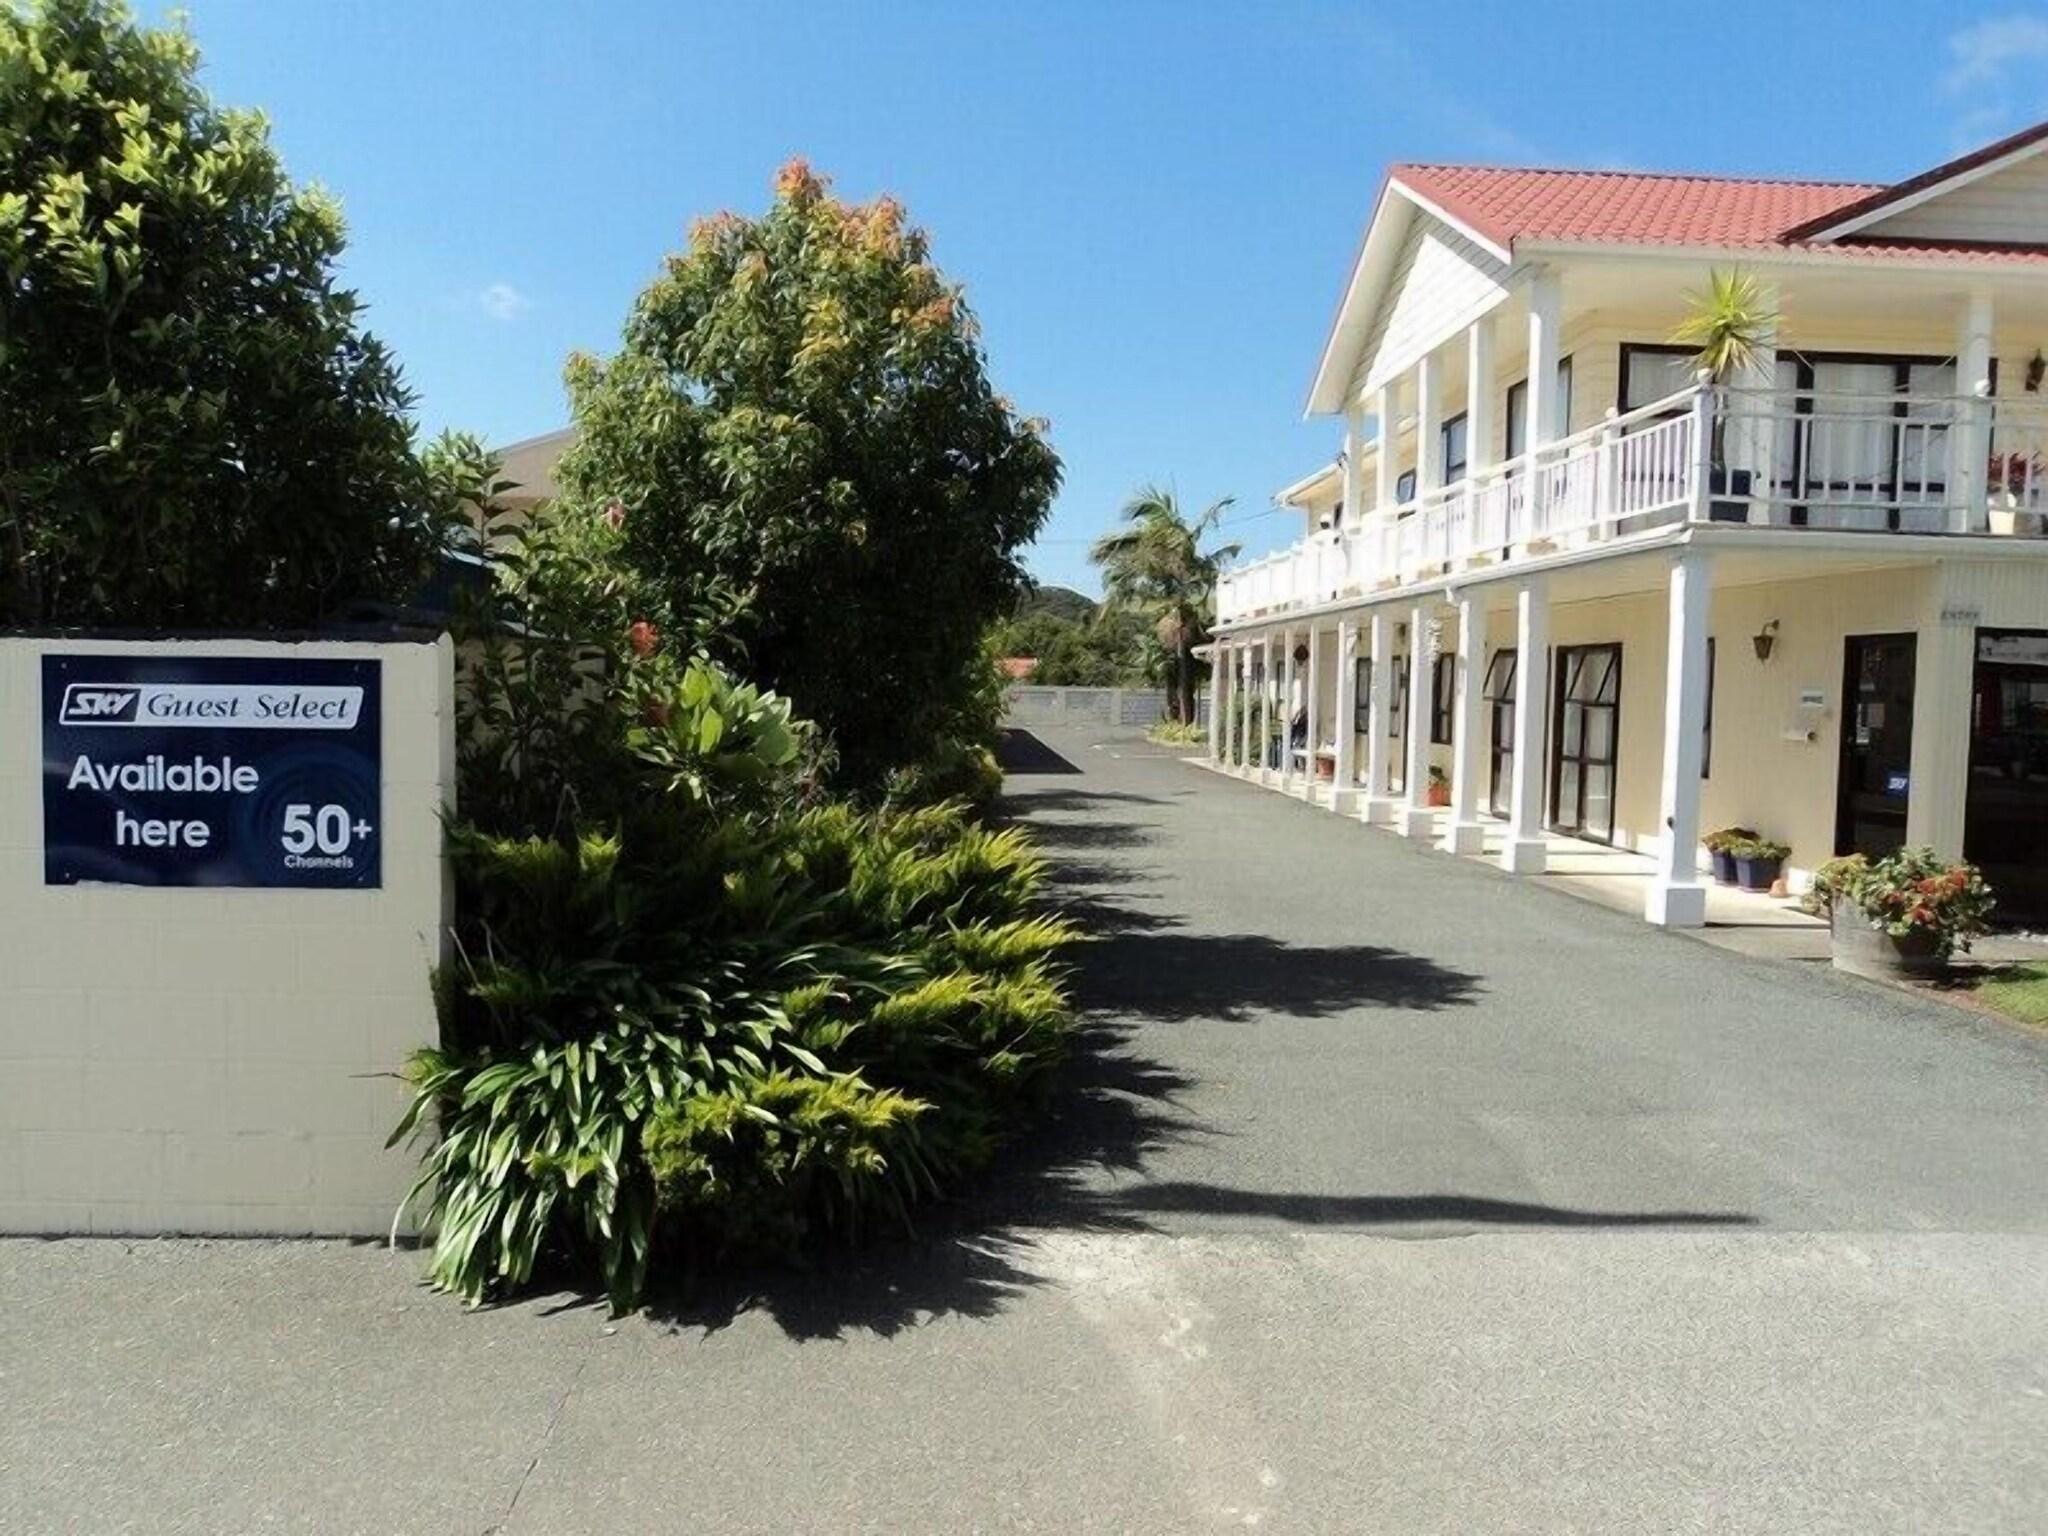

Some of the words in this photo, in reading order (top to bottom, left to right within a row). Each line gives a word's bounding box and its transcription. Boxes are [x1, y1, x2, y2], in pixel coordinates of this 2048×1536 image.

[69, 693, 133, 716] SKY
[149, 693, 239, 718] Guest
[256, 694, 349, 720] Select
[67, 755, 260, 793] Available
[115, 811, 210, 848] here
[281, 804, 373, 854] 50+
[284, 855, 354, 868] Channels
